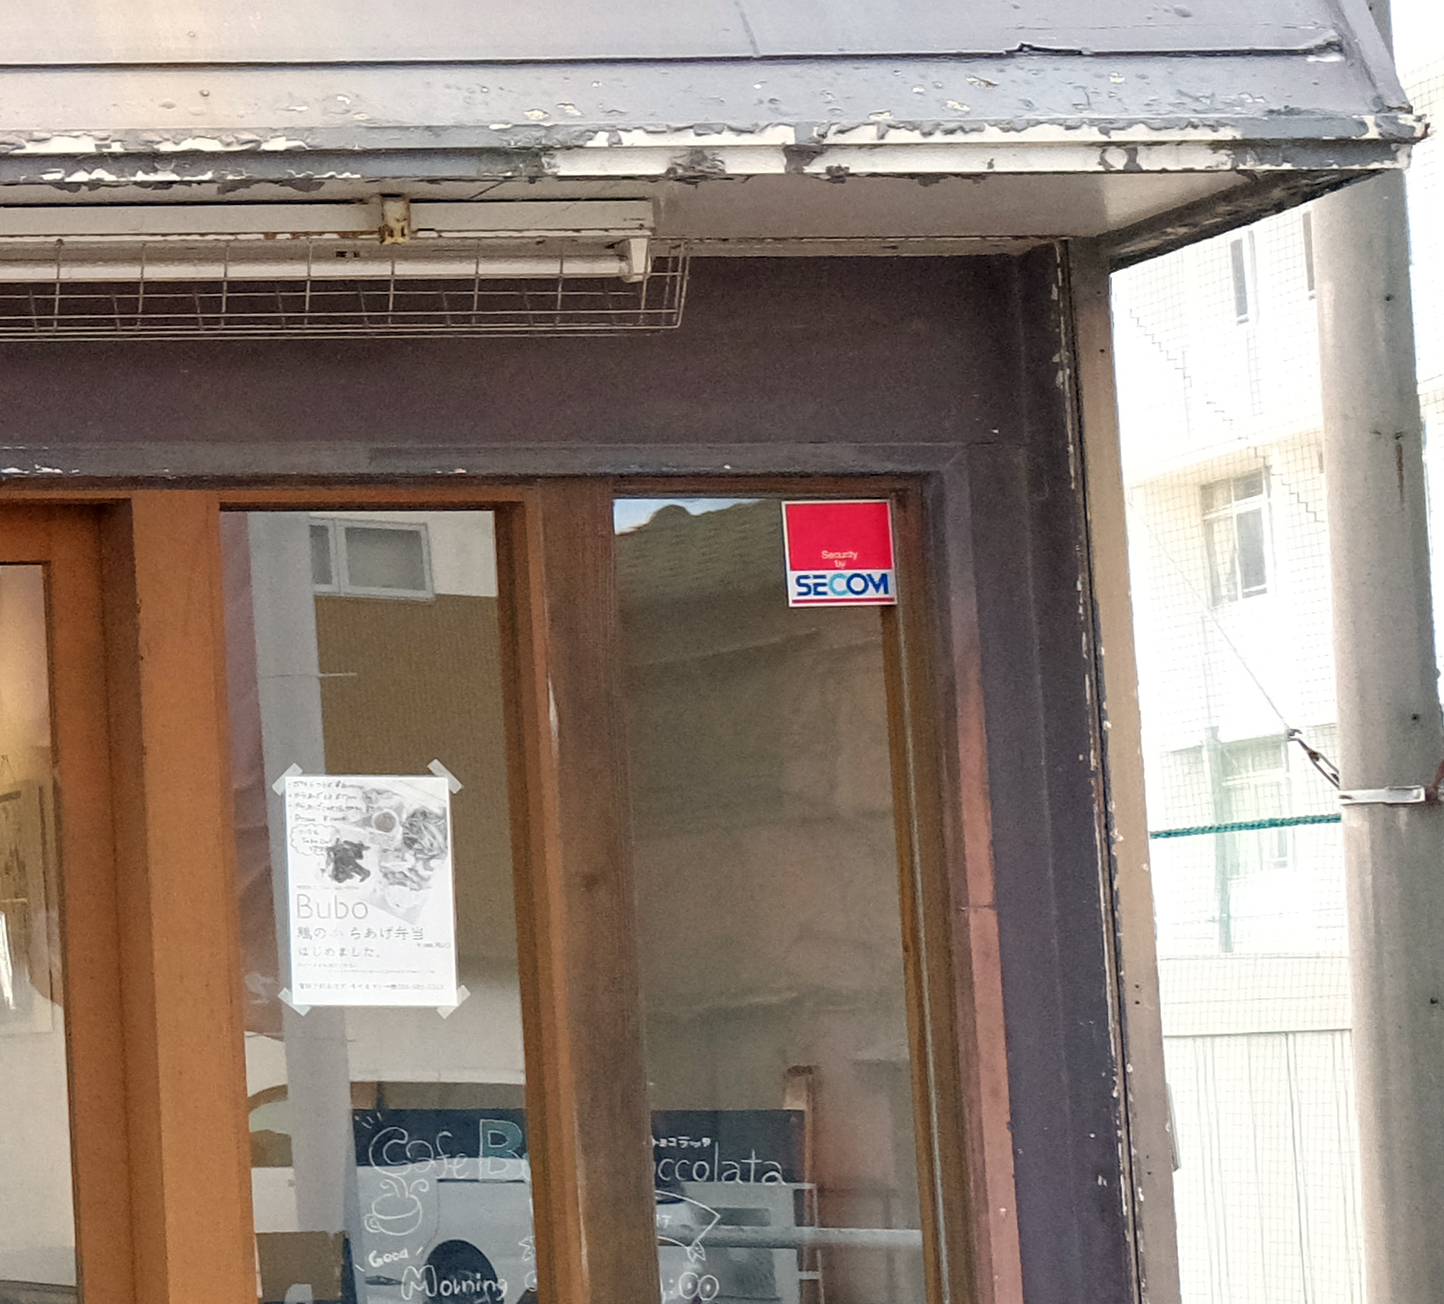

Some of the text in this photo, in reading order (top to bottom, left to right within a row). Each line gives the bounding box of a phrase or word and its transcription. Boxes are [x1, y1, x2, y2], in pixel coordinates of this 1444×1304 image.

[795, 573, 889, 597] SECOM
[296, 894, 369, 920] Bubo
[368, 1118, 529, 1183] Cafe B
[400, 1264, 510, 1304] Morning
